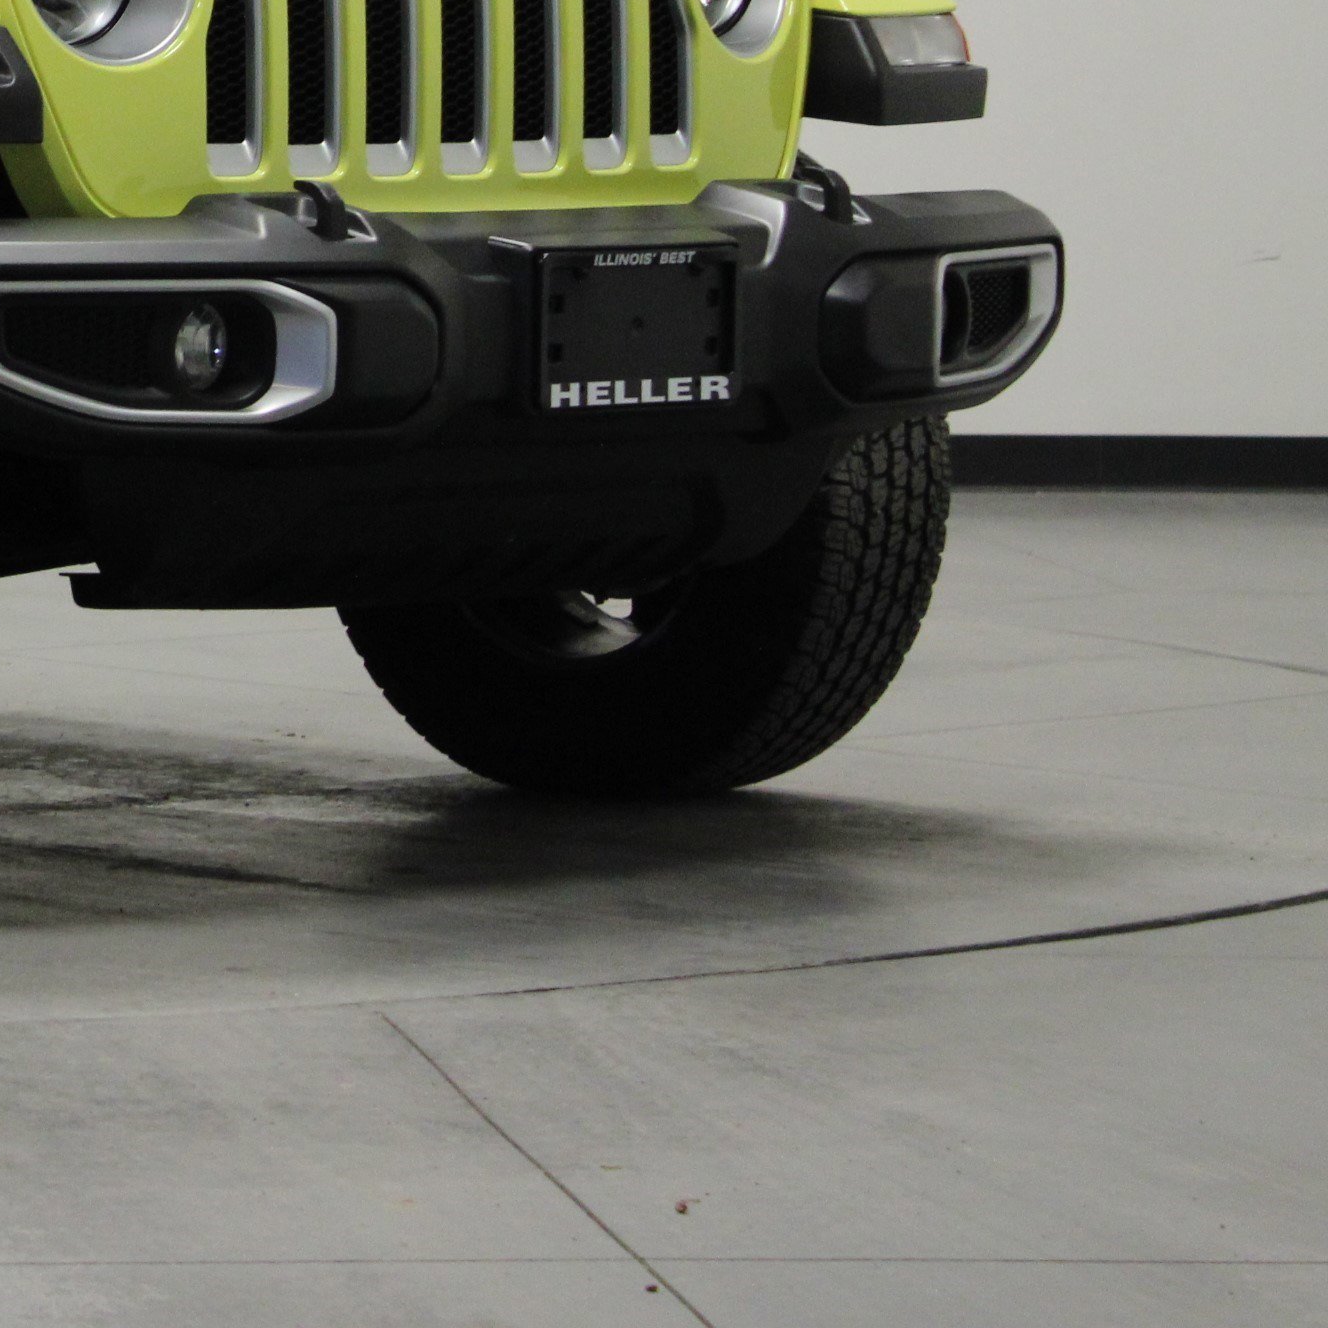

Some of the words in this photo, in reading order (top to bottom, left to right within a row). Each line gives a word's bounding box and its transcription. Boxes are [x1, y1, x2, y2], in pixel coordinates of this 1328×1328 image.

[593, 252, 657, 267] ILLINOIS'
[660, 251, 696, 265] BEST
[550, 375, 730, 409] HELLER
